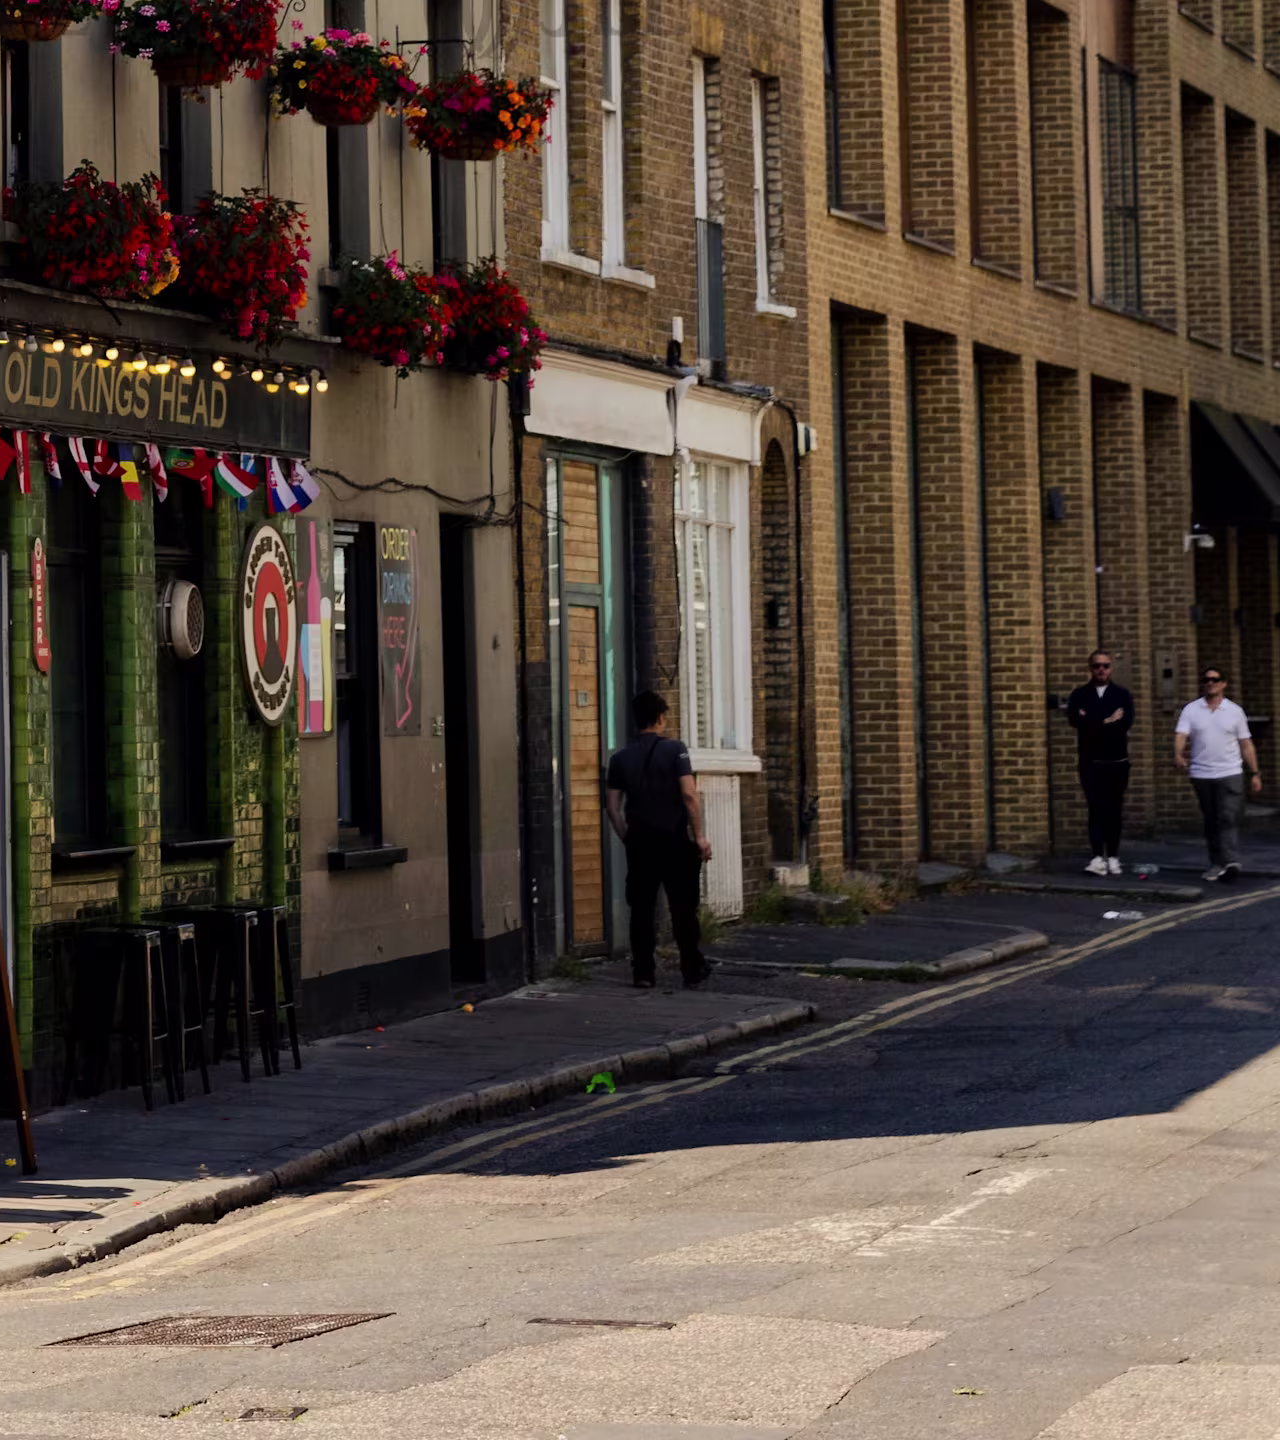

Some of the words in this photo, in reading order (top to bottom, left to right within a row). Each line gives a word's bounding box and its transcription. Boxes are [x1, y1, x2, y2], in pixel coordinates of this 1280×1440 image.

[4, 351, 62, 408] OLD
[70, 361, 151, 419] KINGS
[158, 372, 228, 428] HEAD
[381, 527, 409, 560] ORDER
